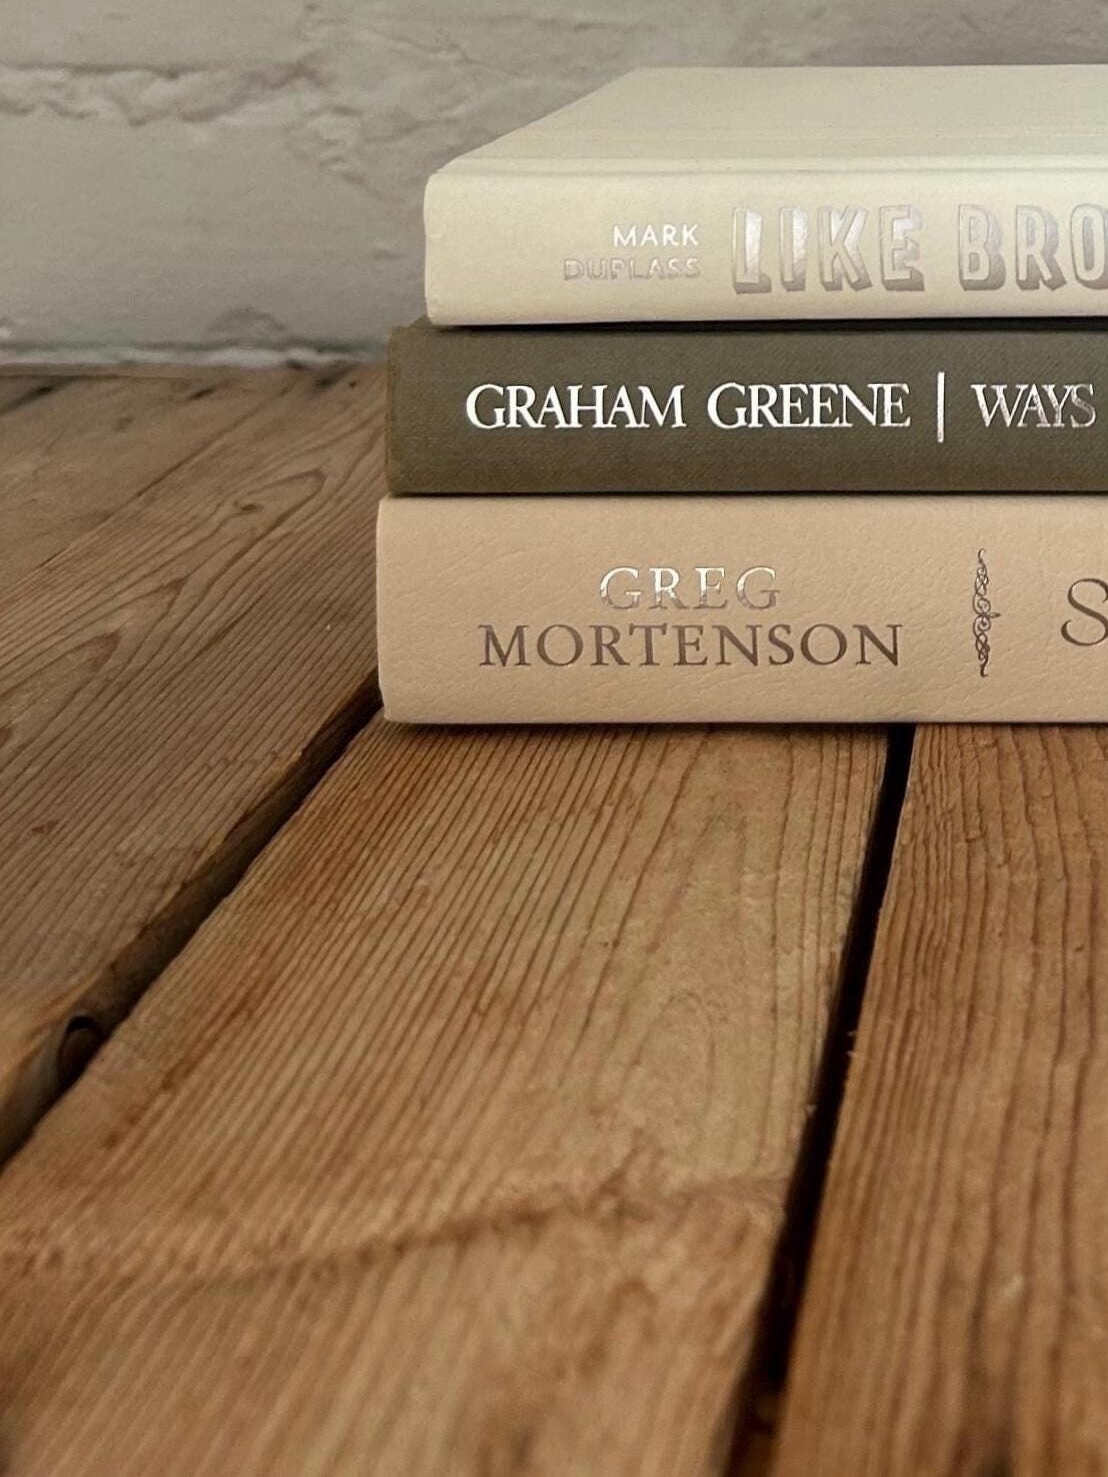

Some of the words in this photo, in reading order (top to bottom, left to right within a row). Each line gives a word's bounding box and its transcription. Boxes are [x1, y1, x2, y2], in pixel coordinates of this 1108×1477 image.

[613, 224, 699, 247] MARK
[731, 204, 926, 294] LIKE
[563, 258, 700, 280] DUPLASS
[465, 383, 687, 429] GRAHAM
[707, 382, 911, 429] GREENE
[970, 383, 1096, 428] WAYS
[599, 566, 780, 612] GREG
[478, 623, 903, 668] MORTENSON
